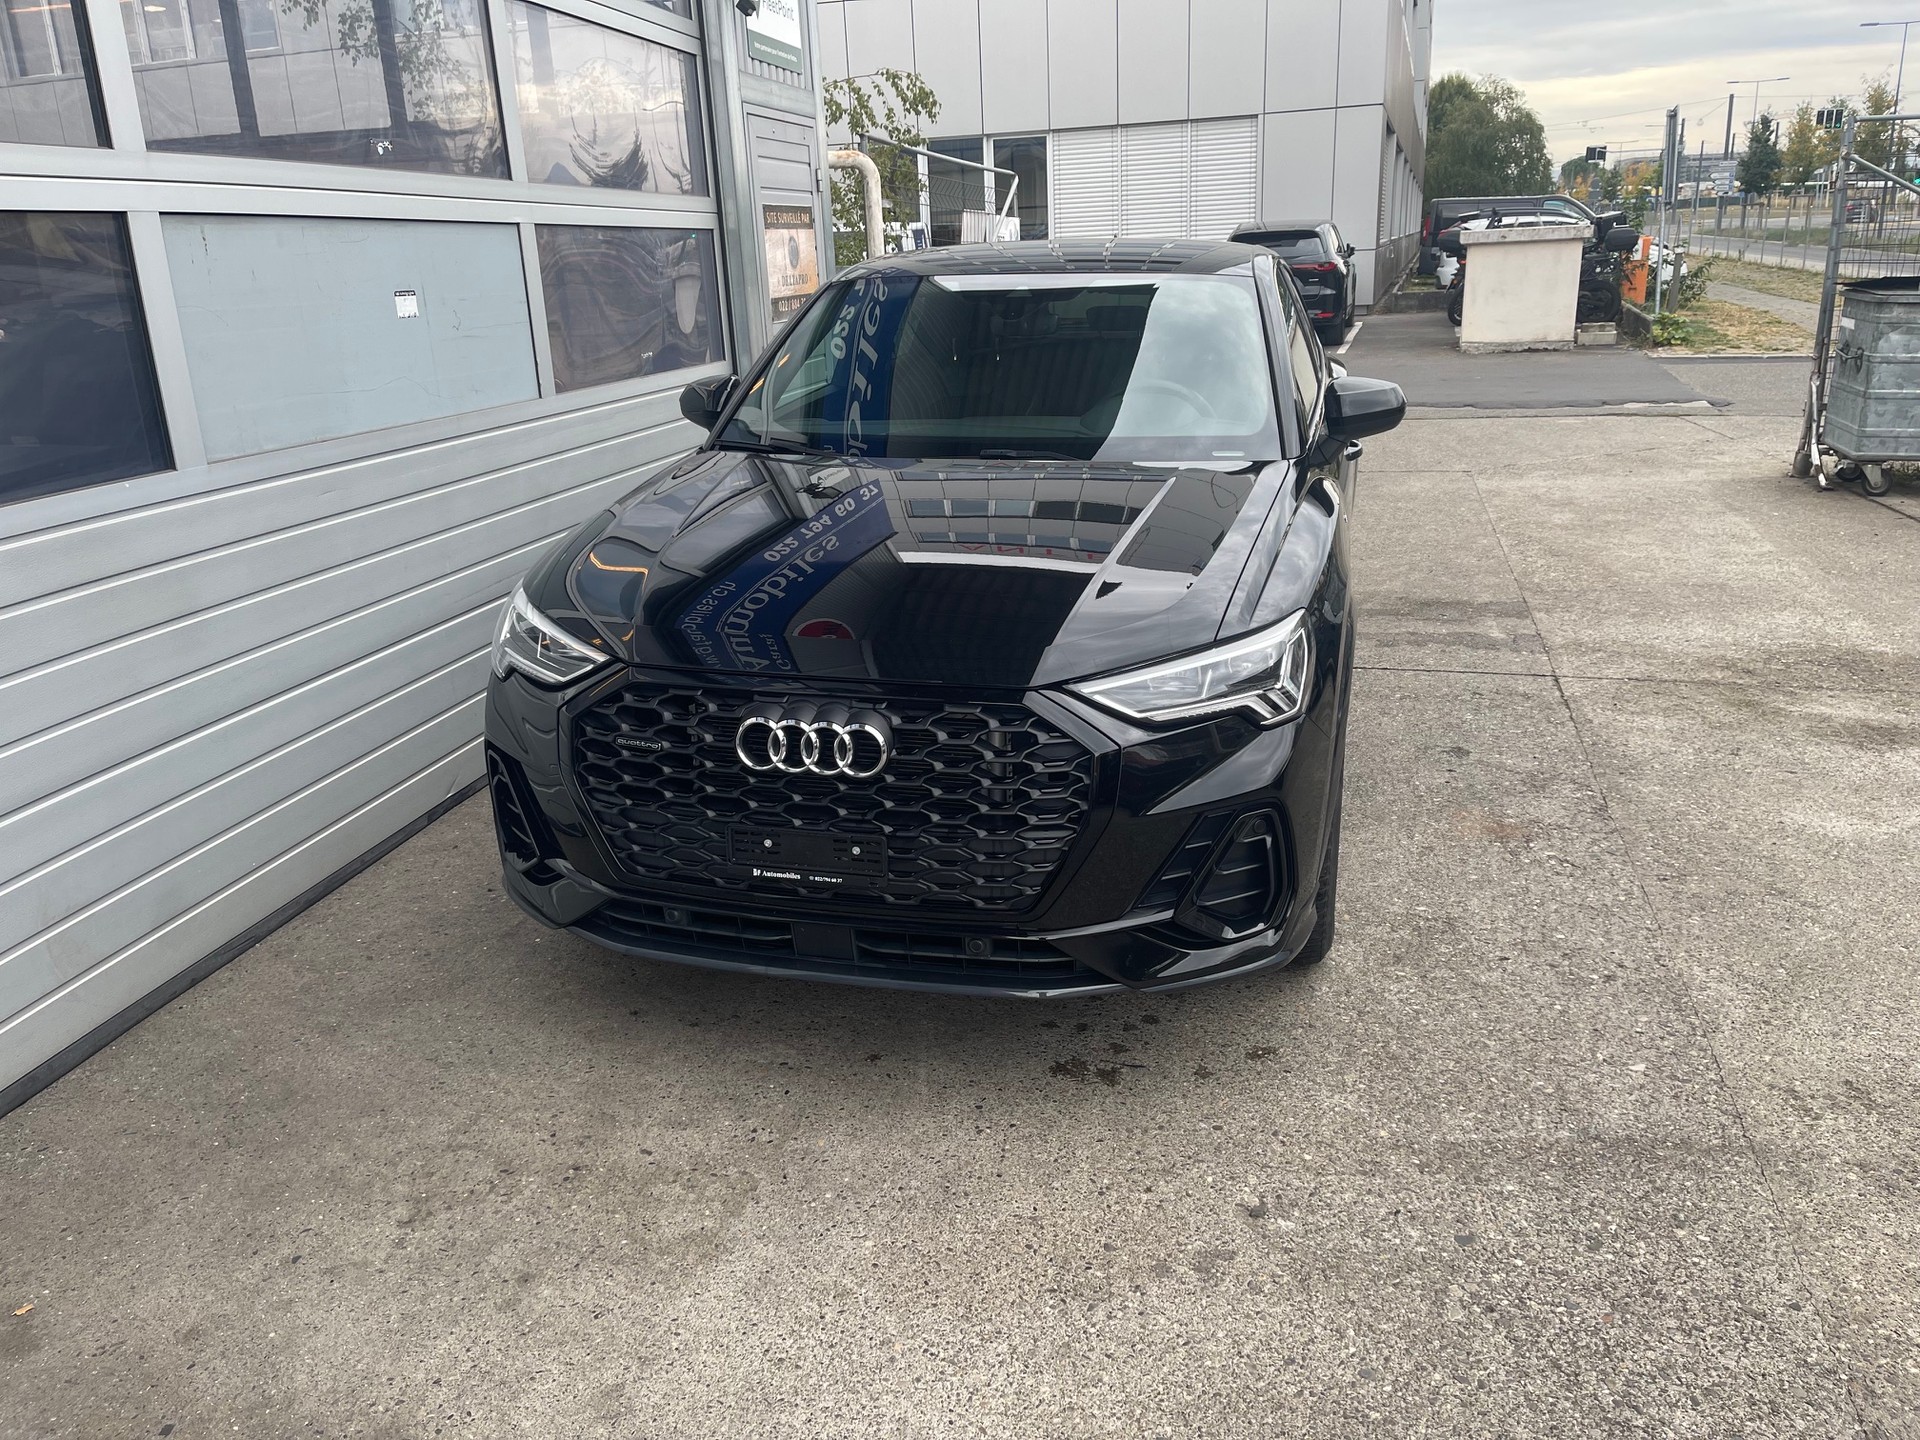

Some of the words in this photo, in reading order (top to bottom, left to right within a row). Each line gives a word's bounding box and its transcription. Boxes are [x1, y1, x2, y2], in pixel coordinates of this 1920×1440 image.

[766, 211, 777, 224] SITE
[777, 209, 801, 224] SURVEILLÉ
[801, 213, 810, 224] PAR
[617, 738, 659, 749] quattro
[762, 870, 801, 880] Automobiles
